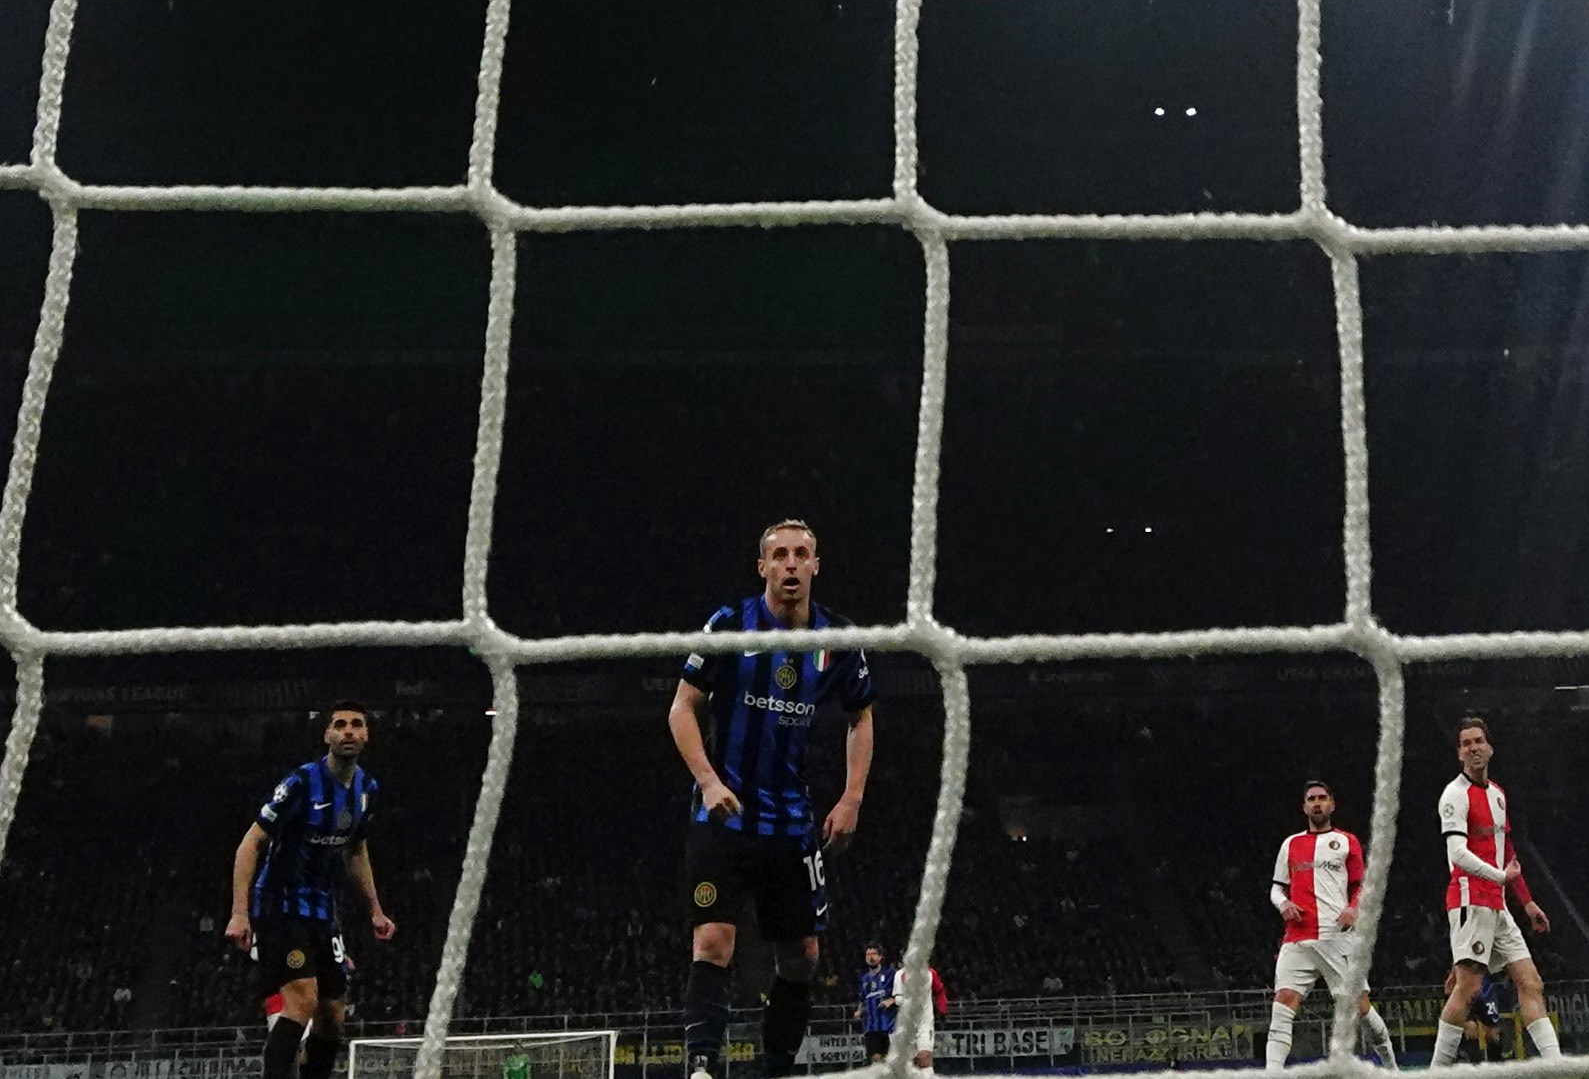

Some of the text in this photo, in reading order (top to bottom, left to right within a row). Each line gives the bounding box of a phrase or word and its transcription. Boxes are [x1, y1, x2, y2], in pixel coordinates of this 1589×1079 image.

[744, 690, 816, 716] betsson
[803, 850, 826, 892] 16
[993, 1030, 1048, 1055] BASE
